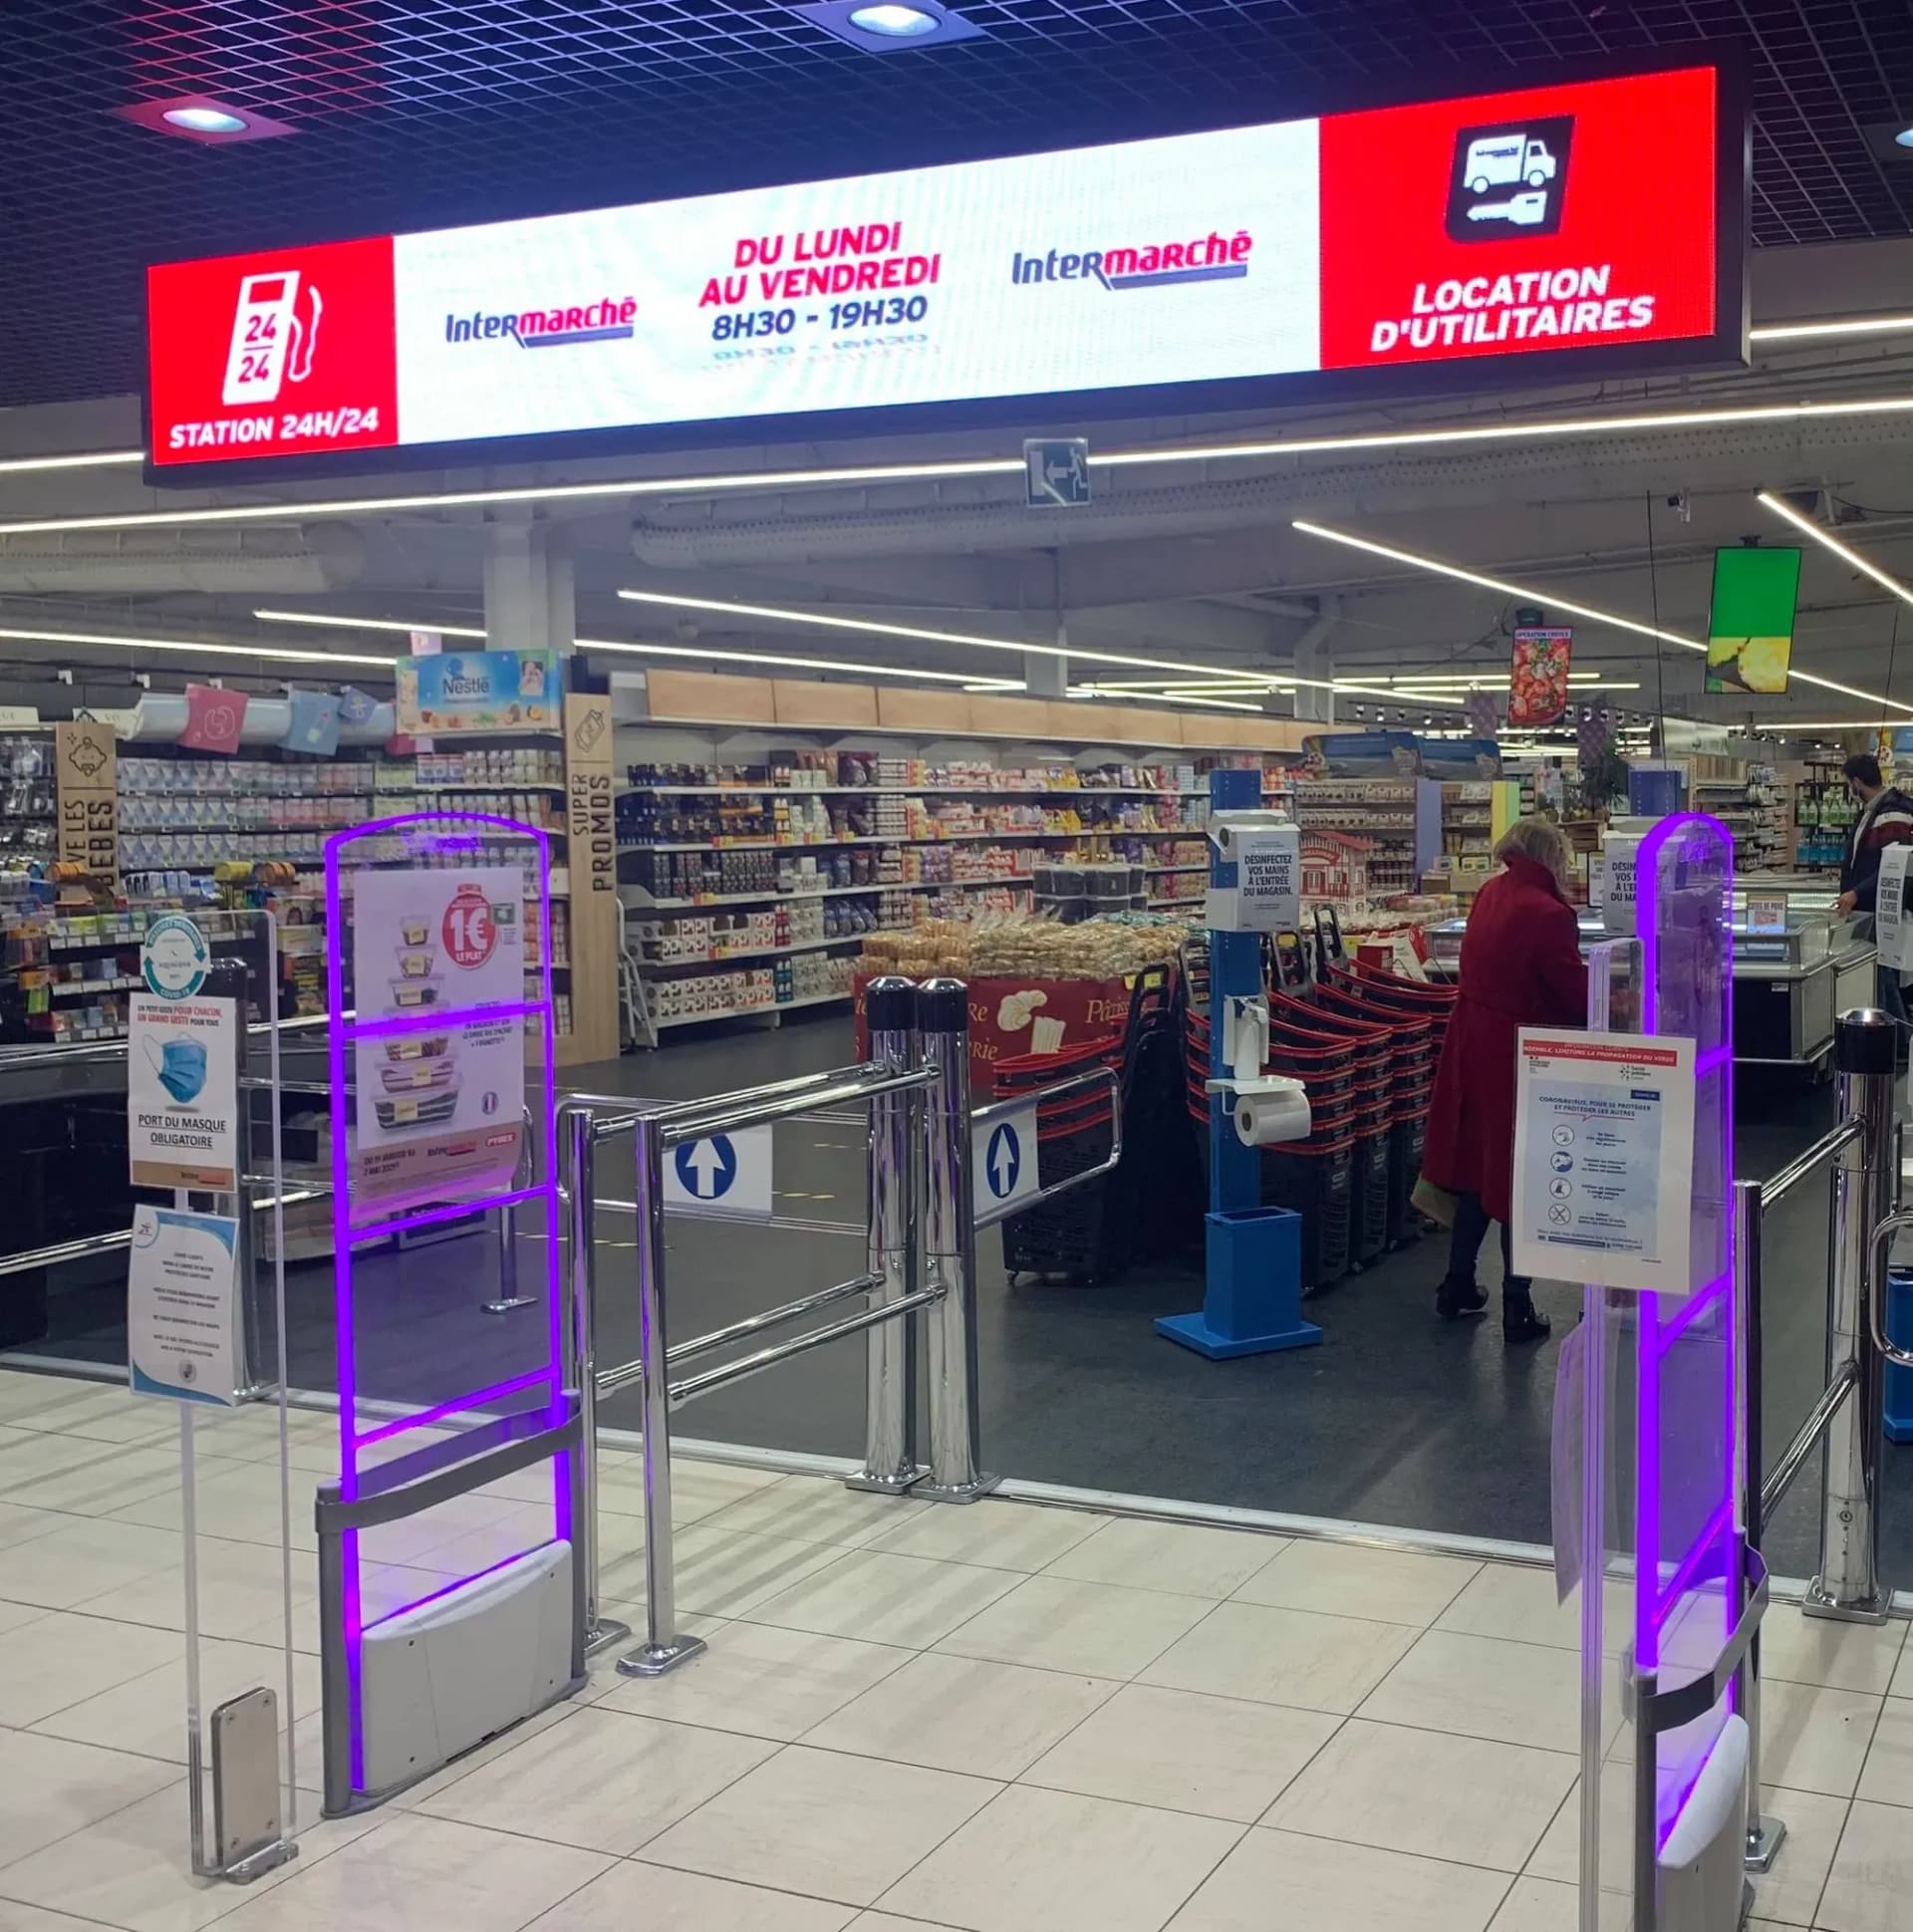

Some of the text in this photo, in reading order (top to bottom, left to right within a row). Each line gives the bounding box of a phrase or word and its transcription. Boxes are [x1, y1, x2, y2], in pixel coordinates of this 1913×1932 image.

[733, 221, 902, 268] DU LUNDI
[699, 253, 941, 308] AU VENDREDI
[1412, 264, 1611, 315] LOCATION
[244, 314, 277, 343] 24
[711, 308, 795, 340] 8H30
[829, 295, 928, 329] 19H30
[1370, 295, 1655, 353] D'UTILITAIRES
[238, 355, 270, 383] 24
[169, 407, 380, 448] STATION 24H/24
[442, 677, 489, 694] Nestlé
[65, 800, 85, 831] LES
[572, 774, 590, 836] SUPER
[590, 776, 613, 892] PROMOS
[1248, 866, 1289, 875] VOS MAINS
[1615, 873, 1631, 882] VOS
[1243, 888, 1255, 897] DU
[1611, 893, 1622, 902] DU
[450, 908, 488, 952] 1€
[456, 953, 464, 962] LE
[138, 1114, 226, 1131] PORT DU MASQUE
[150, 1132, 212, 1148] OBLIGATOIRE
